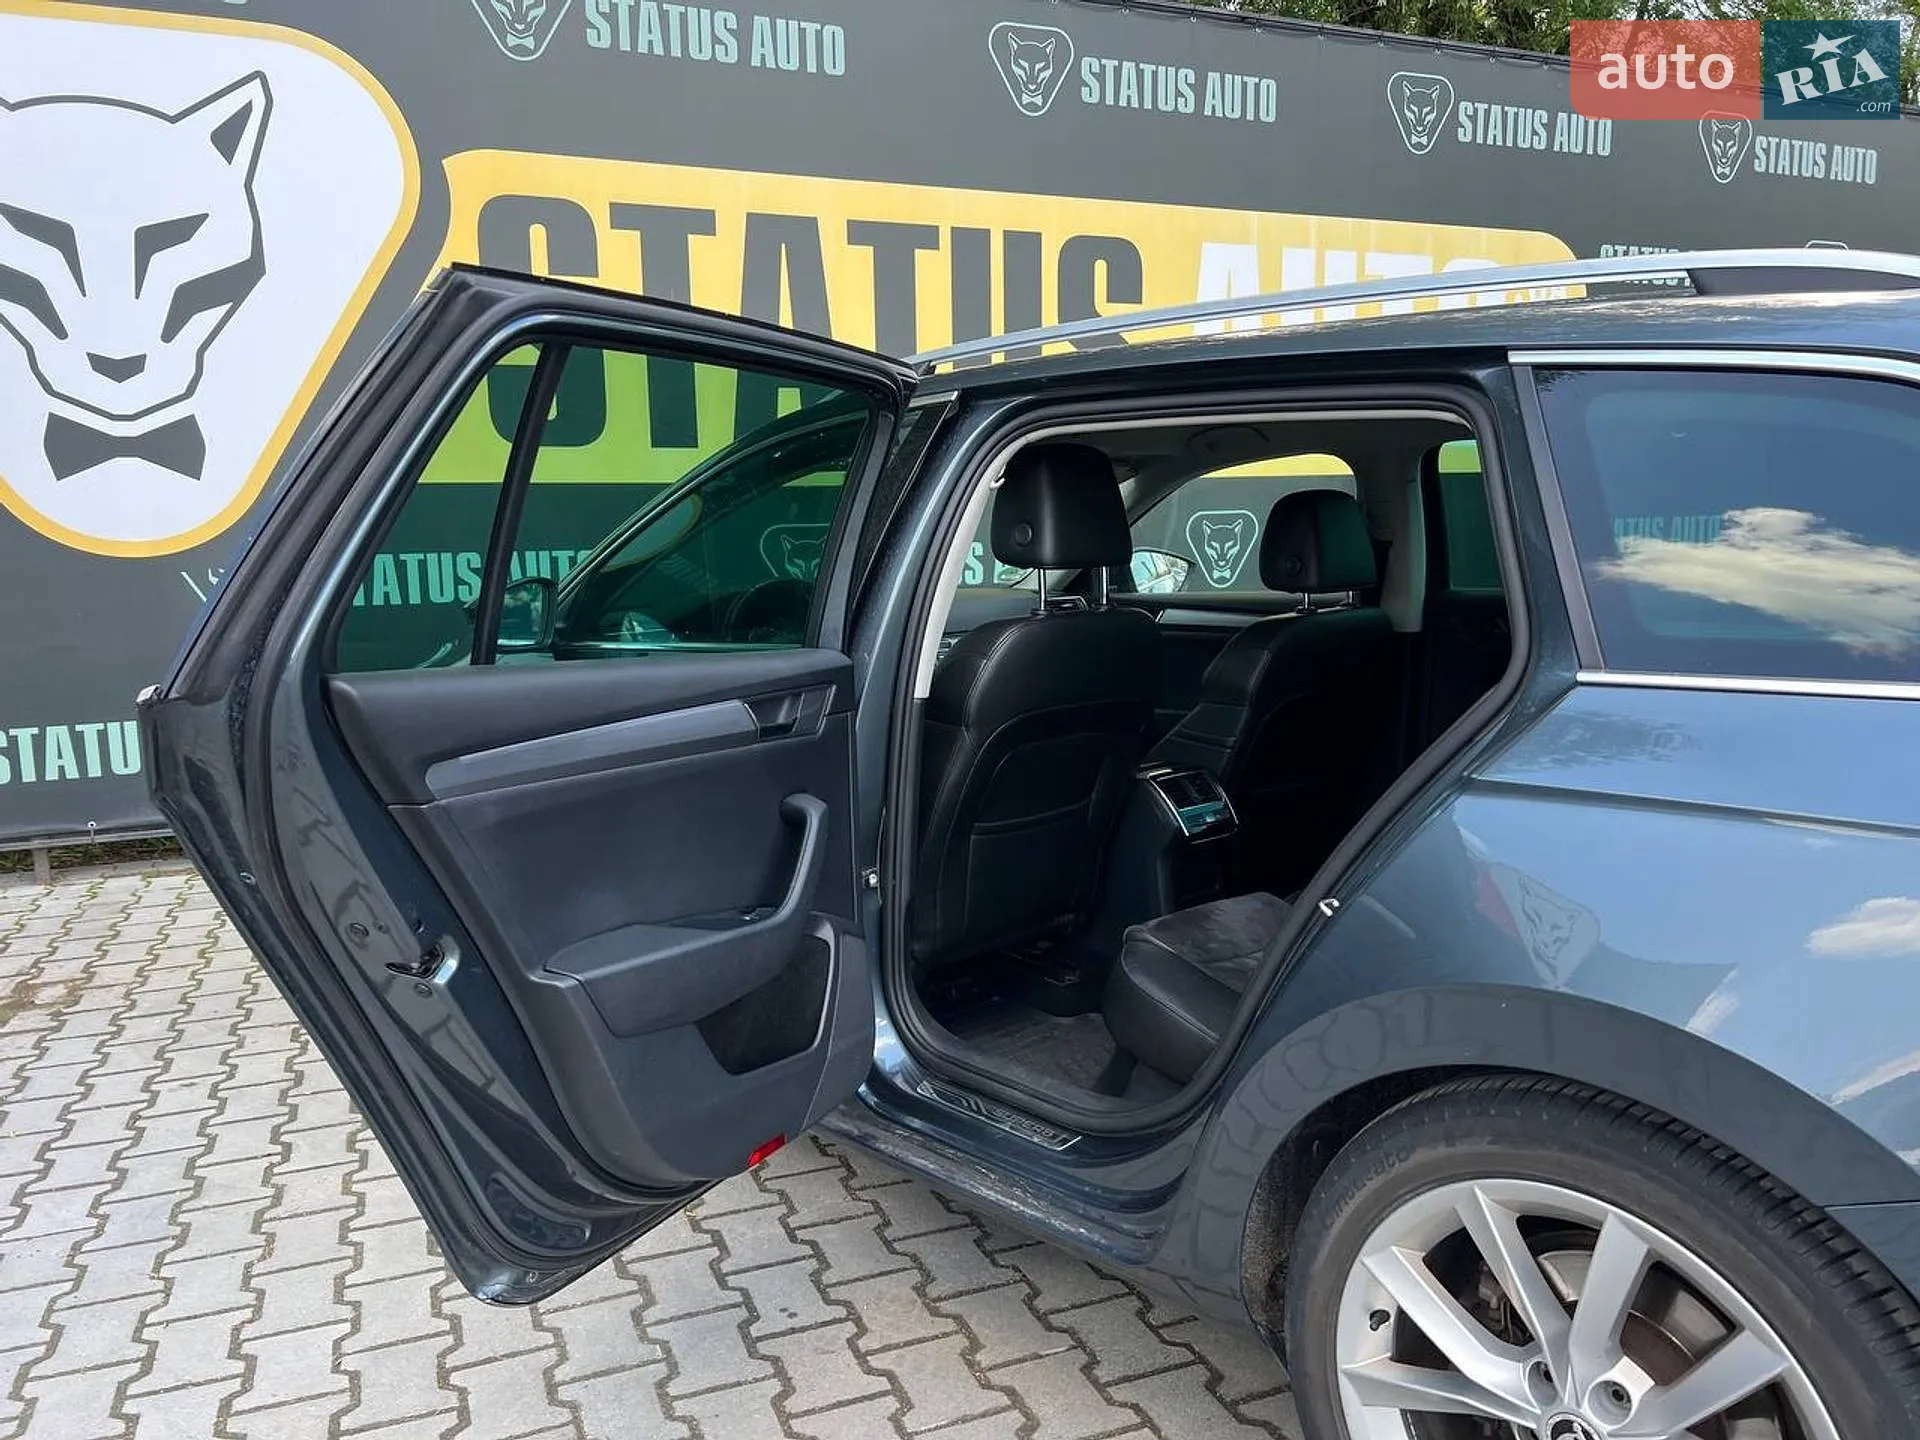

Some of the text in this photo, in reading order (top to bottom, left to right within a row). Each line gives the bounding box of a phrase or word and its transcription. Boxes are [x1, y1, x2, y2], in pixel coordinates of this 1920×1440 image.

[583, 0, 846, 76] STATUS AUTO
[1081, 56, 1277, 123] STATUS AUTO
[1457, 101, 1613, 156] STATUS AUTO
[1753, 135, 1878, 184] STATUS AUTO
